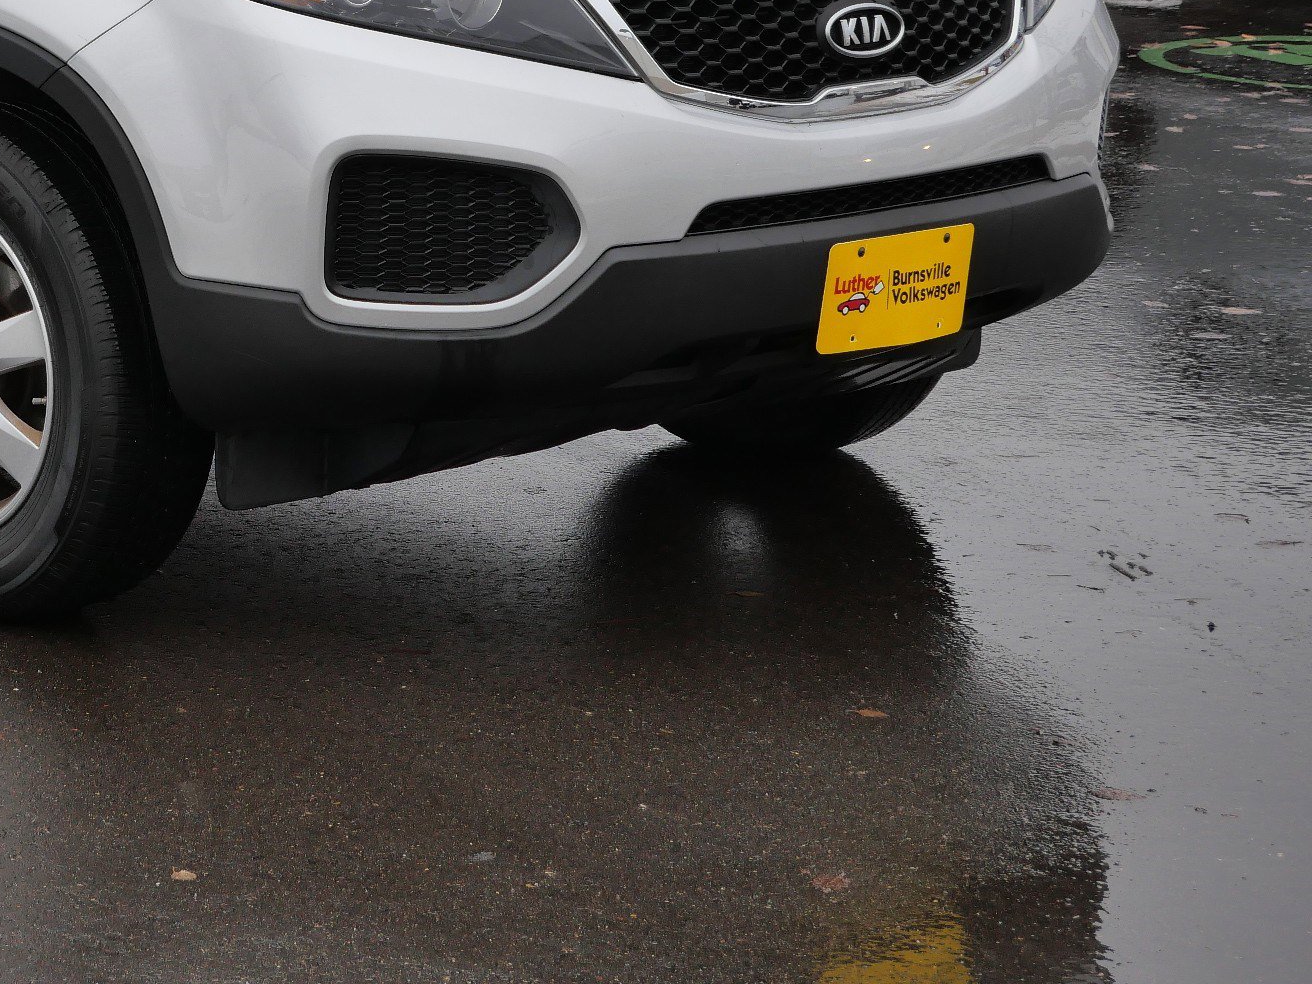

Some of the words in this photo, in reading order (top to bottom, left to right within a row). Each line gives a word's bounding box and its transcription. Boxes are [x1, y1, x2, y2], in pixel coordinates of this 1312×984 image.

[839, 14, 892, 47] KIA
[834, 273, 881, 295] Luther
[892, 262, 952, 287] Burnsville
[892, 280, 961, 306] Volkswagen
